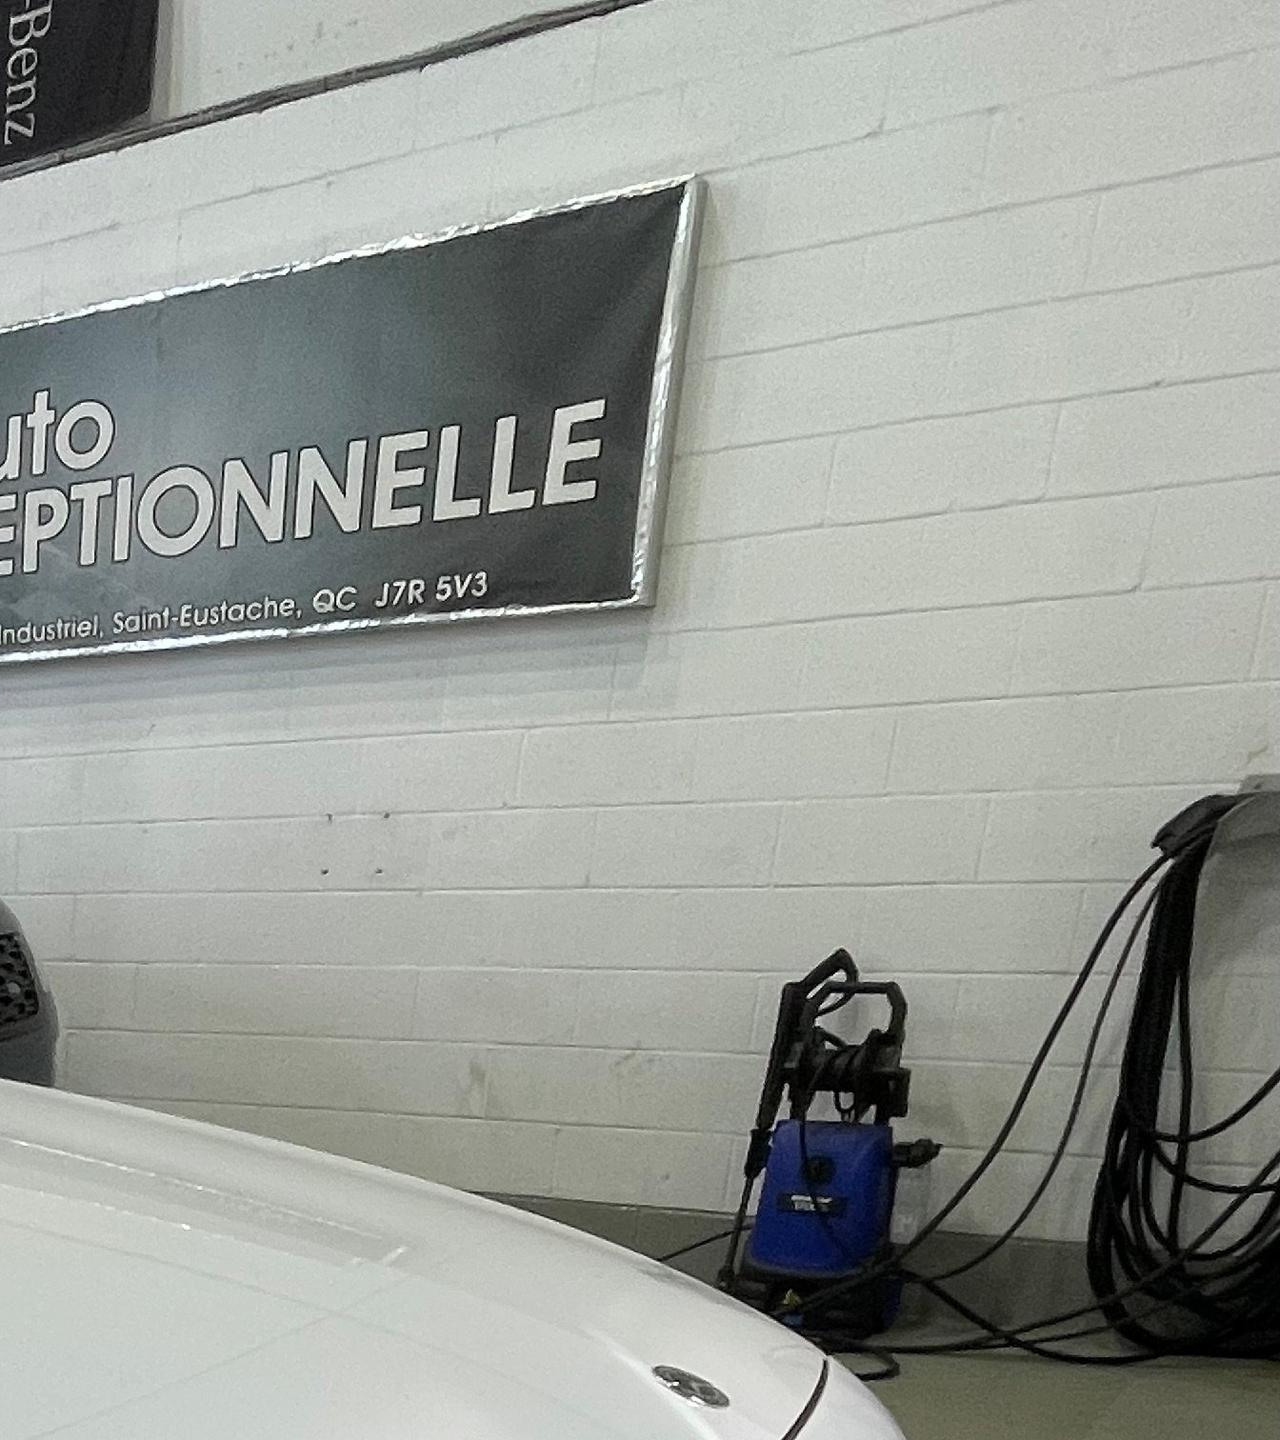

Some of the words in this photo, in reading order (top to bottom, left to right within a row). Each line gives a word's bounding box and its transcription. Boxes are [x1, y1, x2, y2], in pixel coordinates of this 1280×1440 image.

[112, 596, 302, 634] Saint-Eustache,
[312, 586, 358, 613] QC
[375, 579, 426, 608] J7R
[436, 571, 489, 602] 5V3
